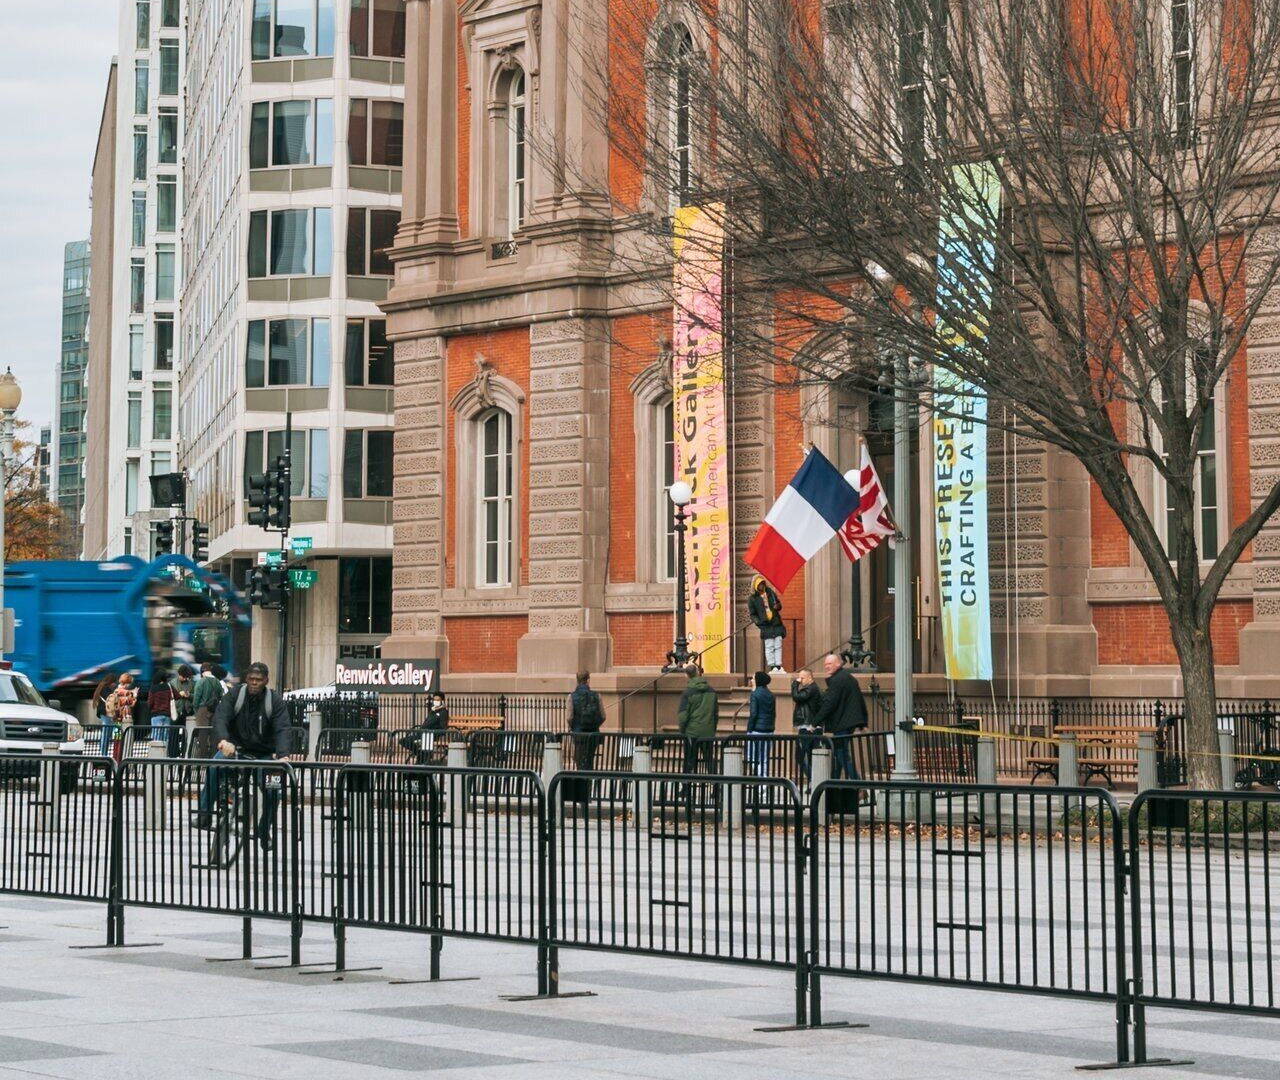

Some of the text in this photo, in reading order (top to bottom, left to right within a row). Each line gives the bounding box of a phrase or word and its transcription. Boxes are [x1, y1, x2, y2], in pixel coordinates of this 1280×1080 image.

[682, 312, 706, 443] Gallery
[704, 405, 718, 428] Art
[705, 434, 720, 510] American
[960, 443, 974, 461] A
[707, 514, 722, 611] Smithsonian
[939, 537, 953, 607] THIS
[959, 469, 977, 607] CRAFTING
[294, 571, 303, 580] 17
[336, 663, 433, 691] Renwick Gallery
